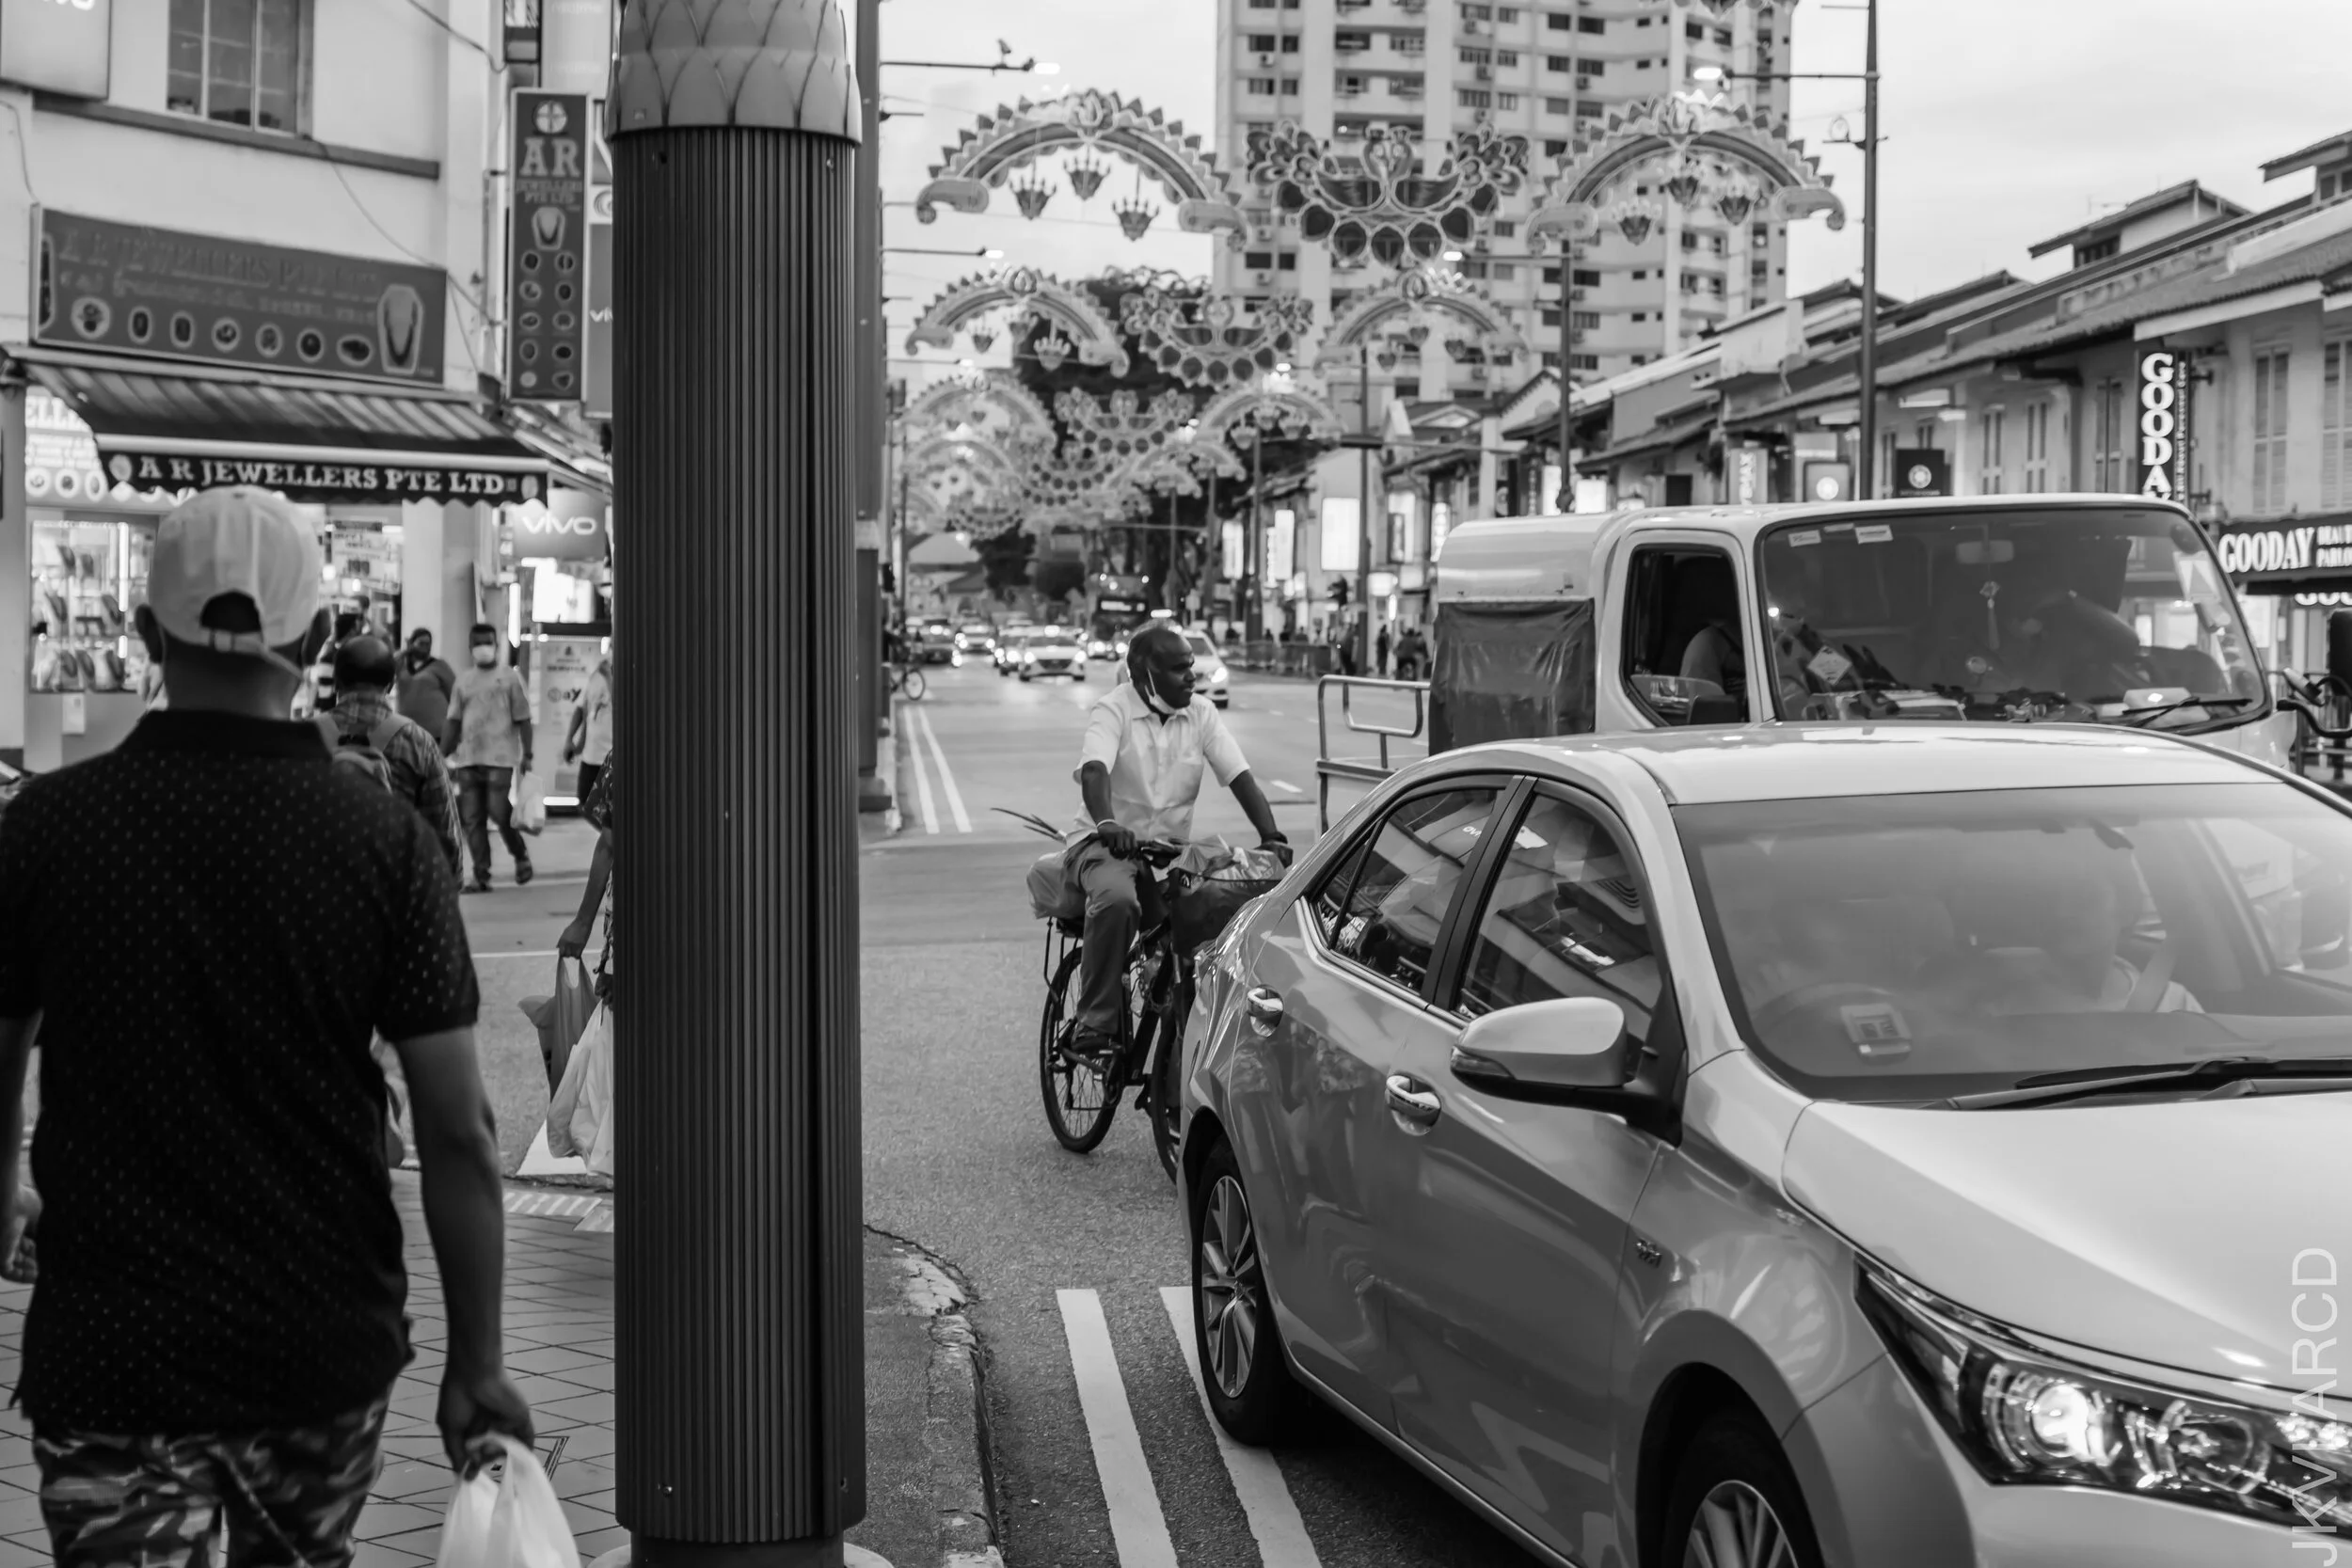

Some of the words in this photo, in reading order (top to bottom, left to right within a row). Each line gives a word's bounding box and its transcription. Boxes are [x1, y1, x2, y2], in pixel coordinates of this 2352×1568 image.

[518, 136, 580, 178] AR
[138, 456, 163, 480] A
[169, 458, 195, 482] R
[199, 459, 378, 490] JEWELLERS
[385, 468, 441, 492] PTE
[449, 471, 504, 496] LTD
[522, 515, 597, 535] vivo
[2217, 527, 2315, 574] GOODAY
